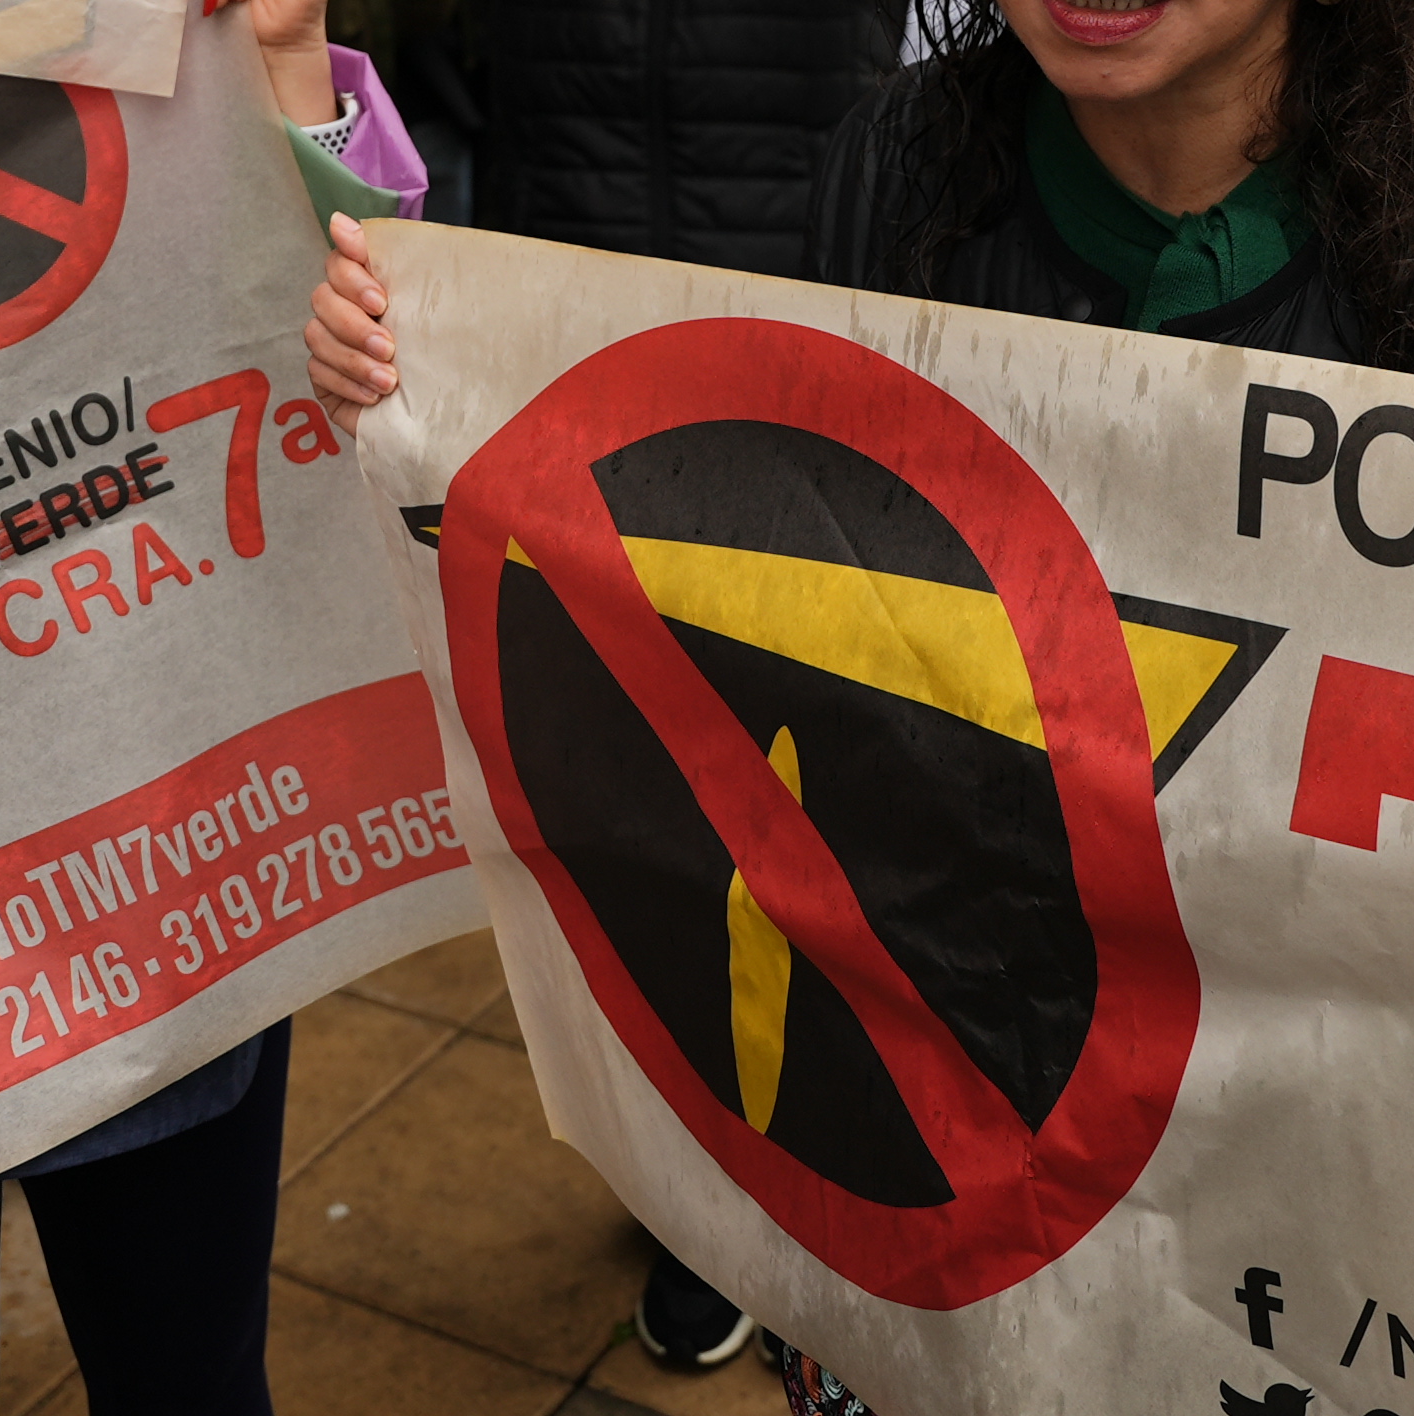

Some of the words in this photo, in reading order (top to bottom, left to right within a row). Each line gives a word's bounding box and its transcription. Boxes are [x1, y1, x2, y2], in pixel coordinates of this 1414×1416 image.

[160, 872, 264, 977] 319
[257, 820, 363, 924] 278
[357, 787, 465, 870] 565
